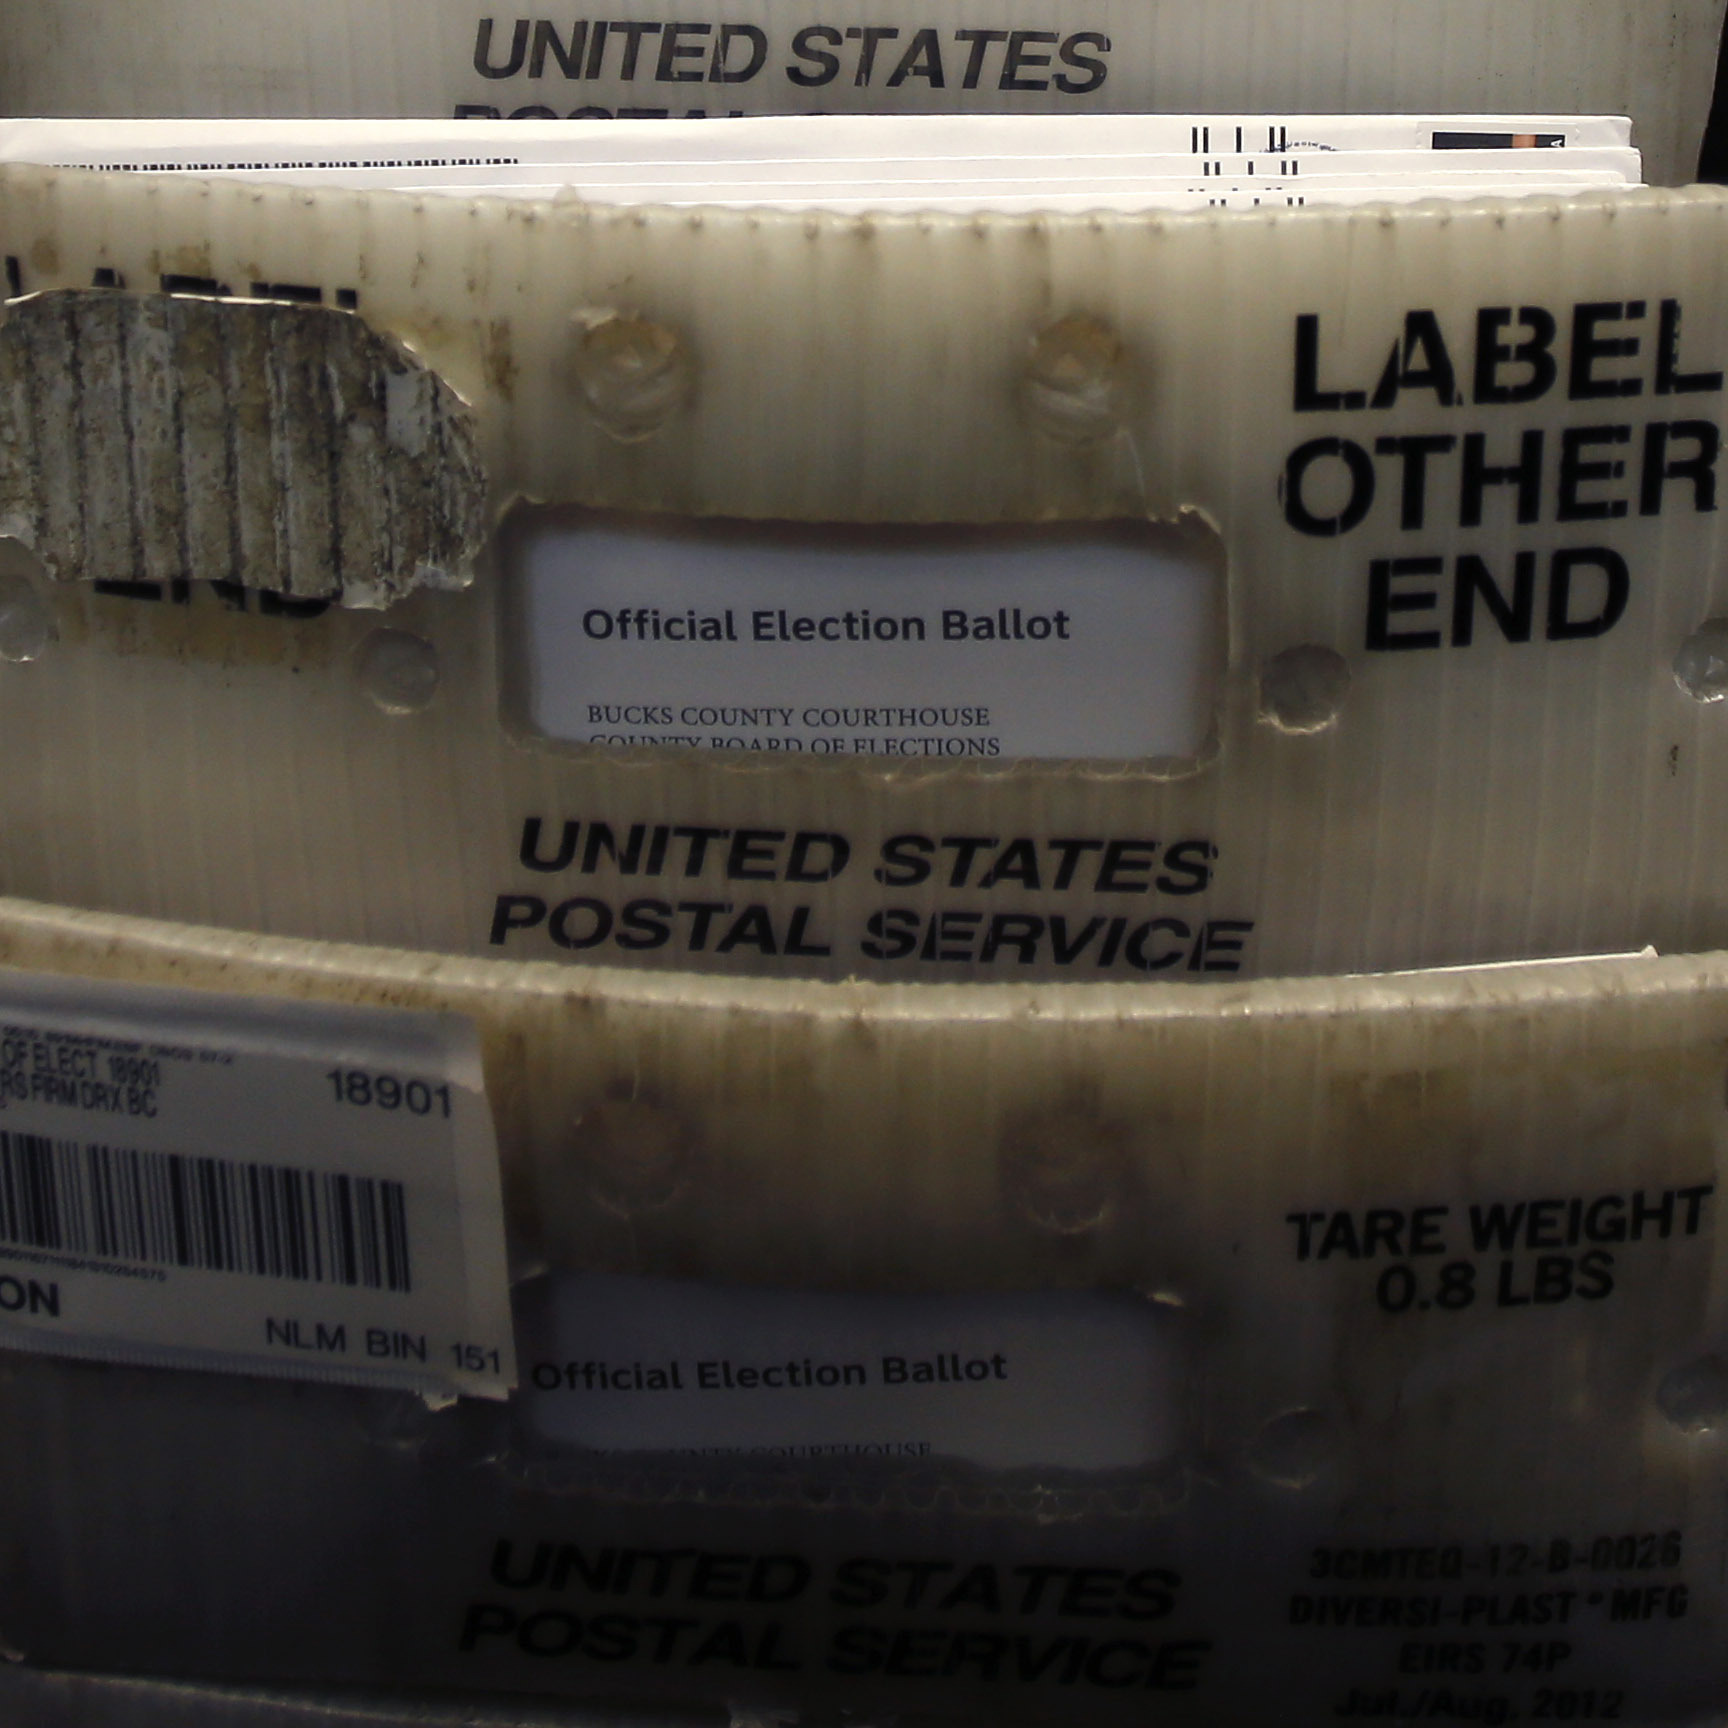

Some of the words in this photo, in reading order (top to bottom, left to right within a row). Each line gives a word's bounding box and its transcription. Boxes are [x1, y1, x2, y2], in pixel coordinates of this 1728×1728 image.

[468, 17, 772, 85] UNITED
[785, 25, 1108, 94] STATES
[1292, 300, 1723, 415] LABEL
[1278, 422, 1720, 539] OTHER
[583, 609, 737, 641] Official
[752, 609, 925, 641] Election
[941, 609, 1070, 641] Ballot
[1362, 544, 1628, 653] END
[587, 705, 672, 725] BUCKS
[681, 706, 793, 728] COUNTY
[802, 707, 989, 727] COURTHOUSE
[516, 817, 850, 888] UNITED
[876, 831, 1219, 898] STATES
[489, 894, 836, 960] POSTAL
[858, 906, 1254, 975] SERVICE
[326, 1069, 452, 1119] 18901
[1286, 1207, 1452, 1262] TARE
[1467, 1185, 1713, 1255] WEIGHT
[1374, 1262, 1474, 1312] 0.8
[1493, 1254, 1613, 1305] LBS
[266, 1317, 345, 1354] NLM
[366, 1329, 427, 1362] BIN
[451, 1342, 502, 1373] 151
[532, 1361, 682, 1391] Official
[697, 1357, 866, 1389] Election
[883, 1353, 1007, 1385] Ballot
[1609, 1584, 1688, 1622] MFG
[1400, 1642, 1486, 1673] EIRS
[1501, 1639, 1572, 1673] 74P
[1532, 1689, 1624, 1720] 2012
